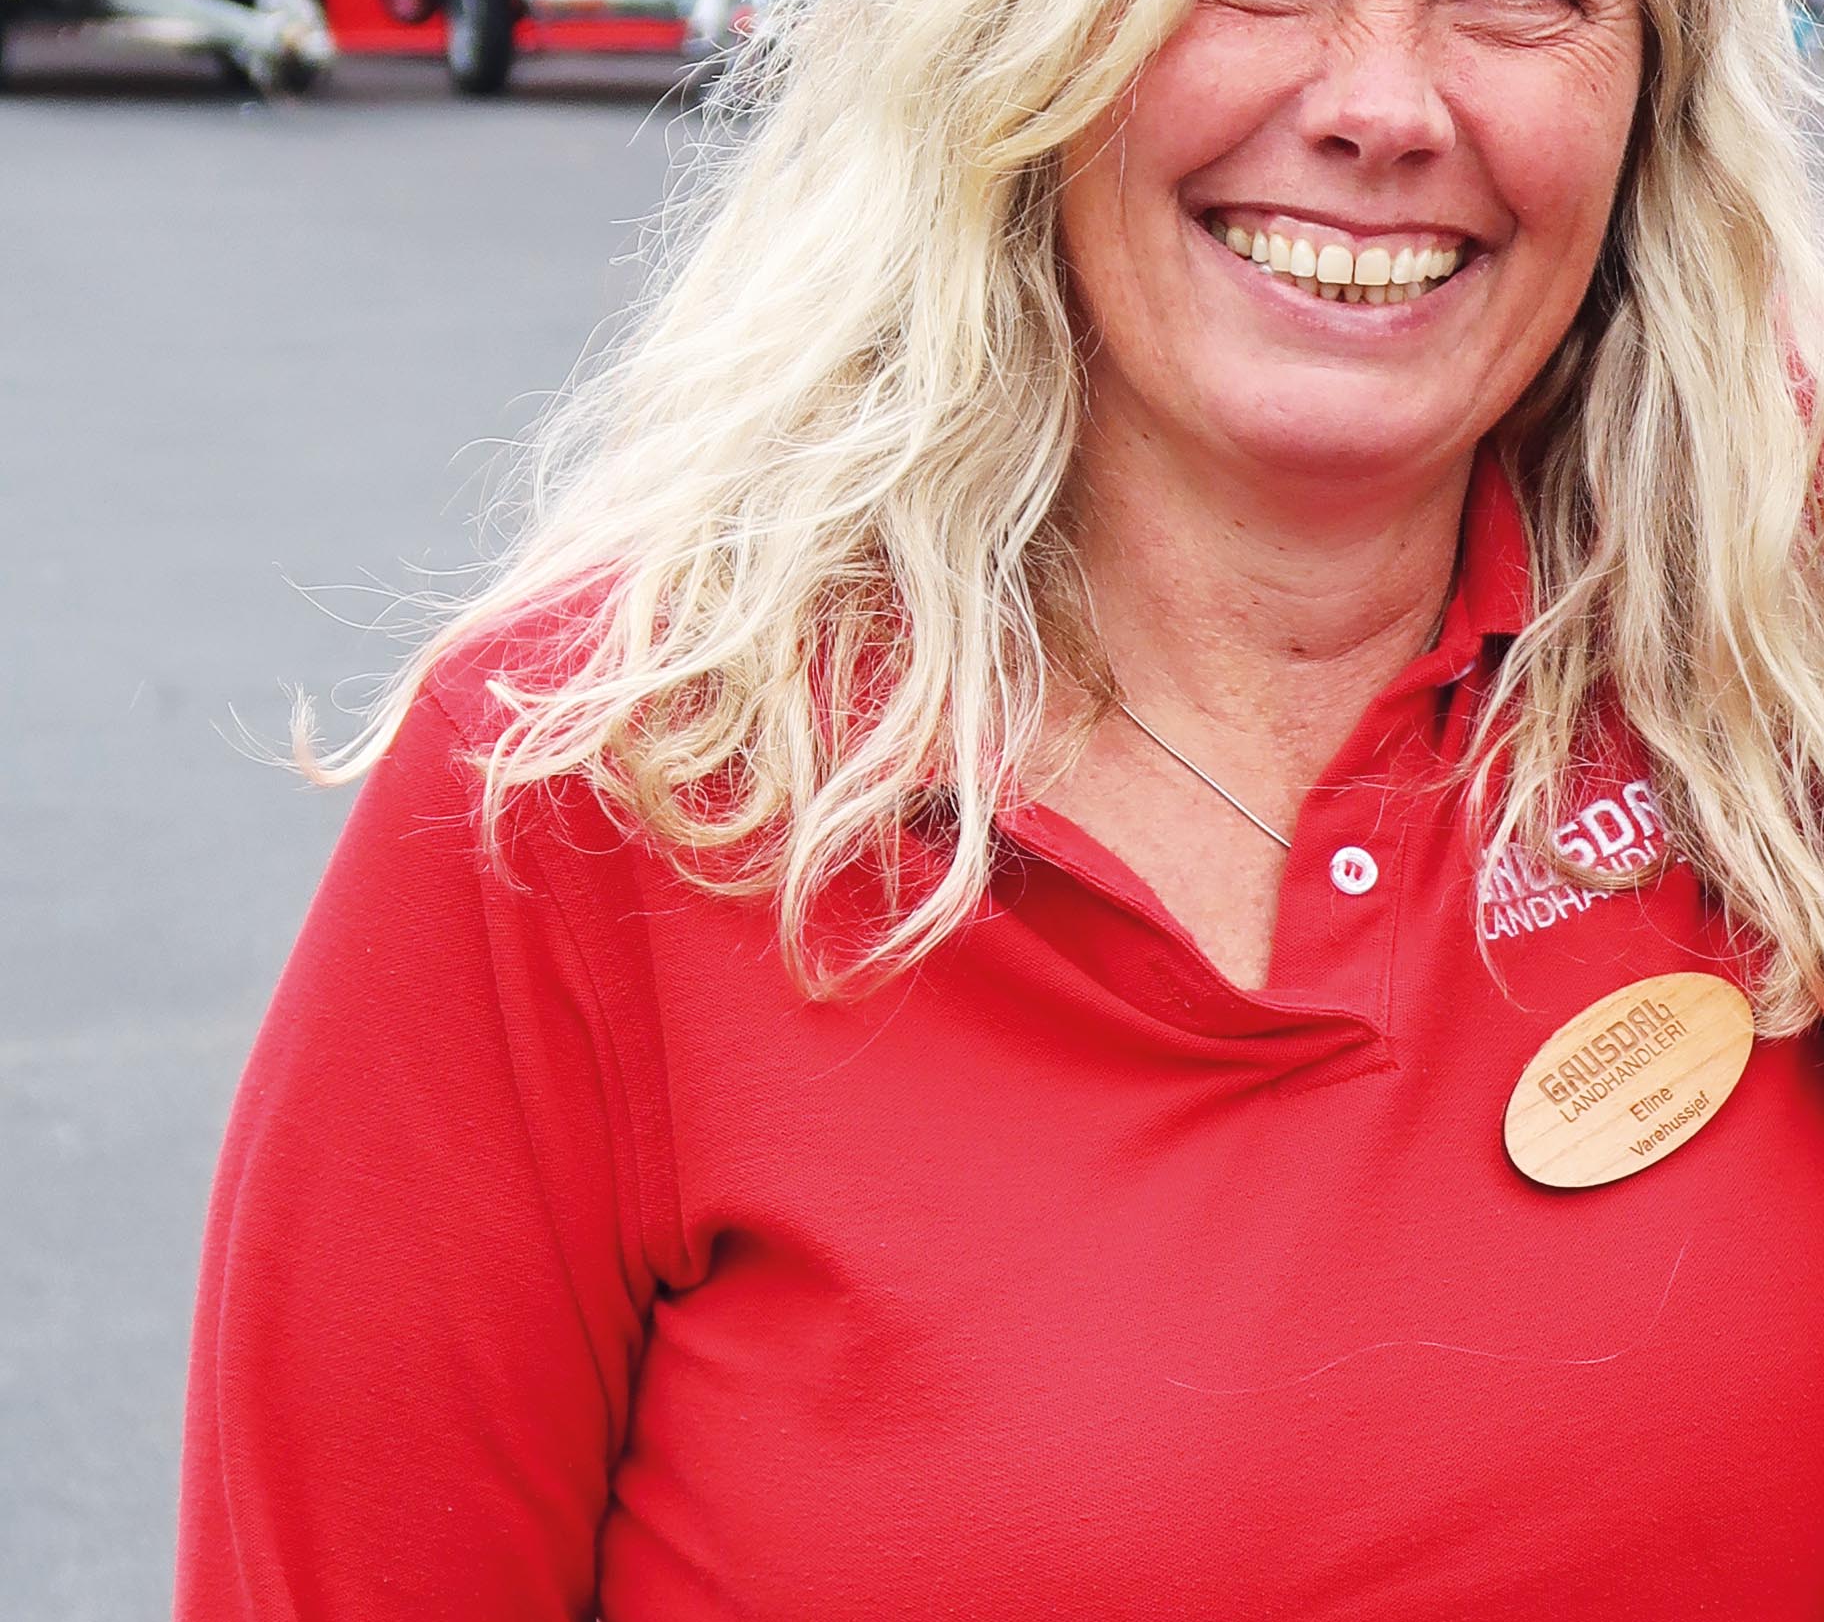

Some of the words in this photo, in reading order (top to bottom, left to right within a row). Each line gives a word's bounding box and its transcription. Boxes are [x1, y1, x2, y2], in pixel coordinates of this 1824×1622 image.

[1537, 998, 1676, 1107] GAUSDAL
[1559, 1019, 1688, 1124] LANDHANDLERI
[1628, 1089, 1711, 1157] Varehussjef
[1629, 1087, 1674, 1123] Eline
